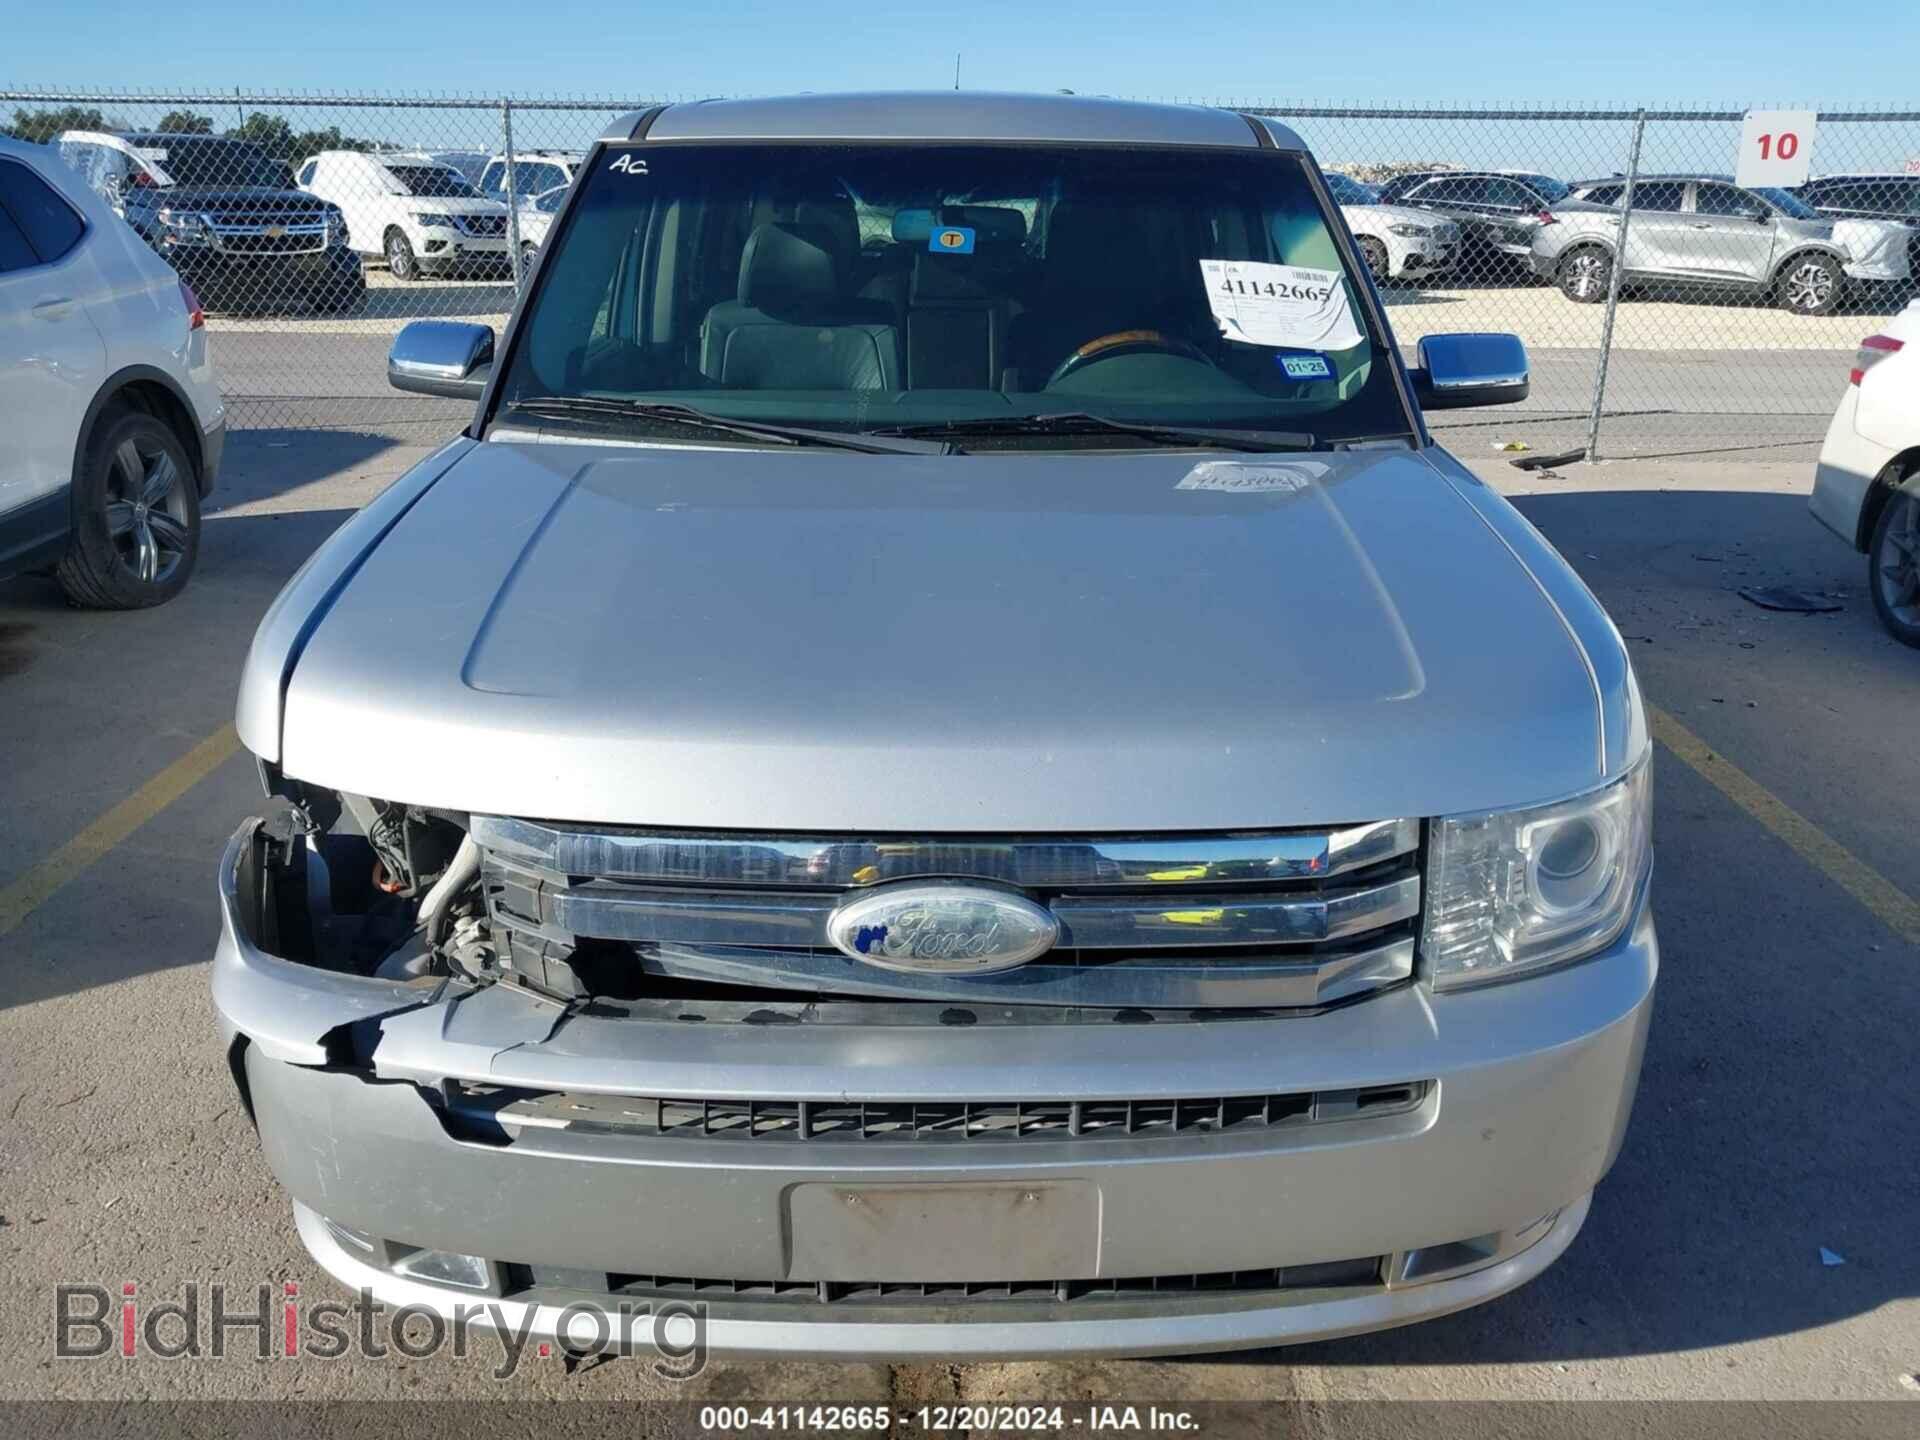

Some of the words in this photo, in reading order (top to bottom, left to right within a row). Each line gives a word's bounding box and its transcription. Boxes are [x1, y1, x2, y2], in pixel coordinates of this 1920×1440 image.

[1758, 133, 1798, 160] 10
[1221, 279, 1331, 303] 41142665
[884, 907, 1000, 958] Ford
